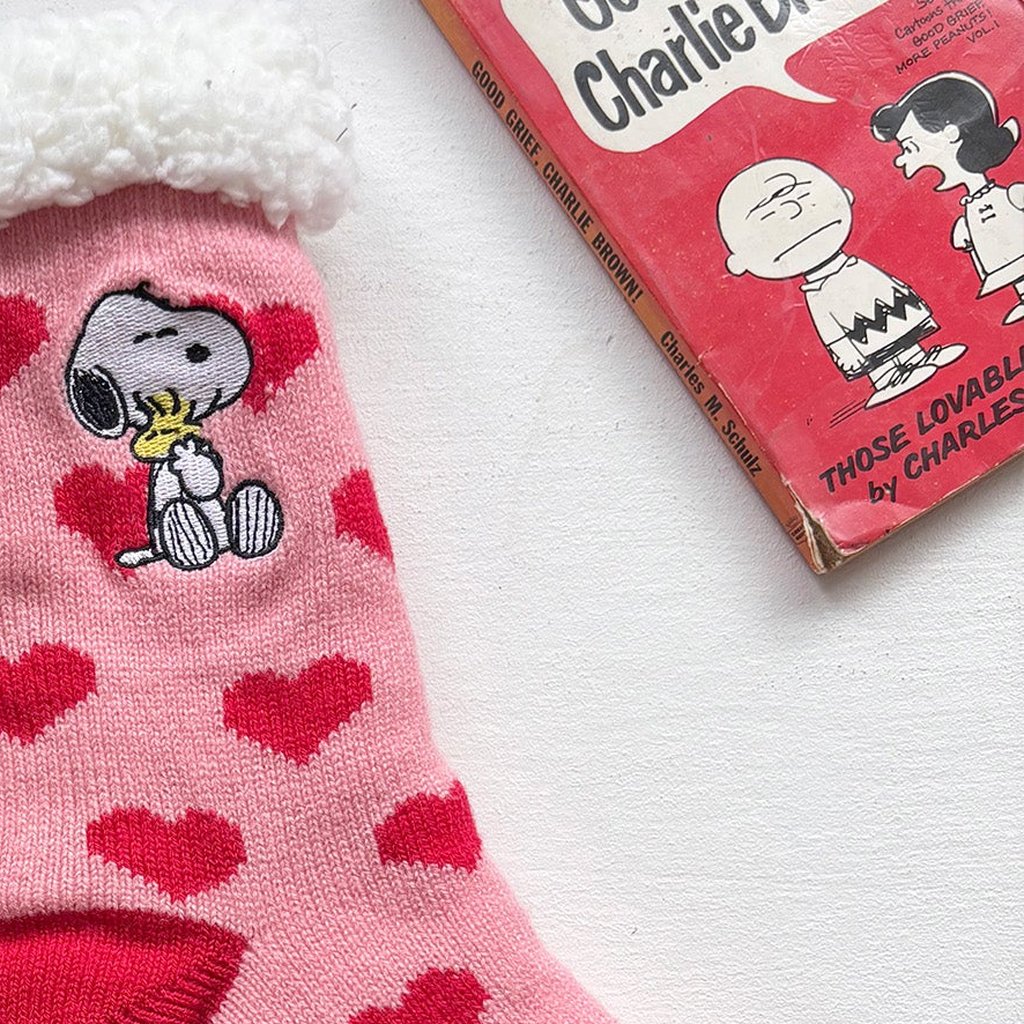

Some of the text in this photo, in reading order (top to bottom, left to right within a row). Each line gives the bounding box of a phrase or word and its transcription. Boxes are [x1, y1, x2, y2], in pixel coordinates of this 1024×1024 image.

[894, 6, 944, 40] Cartoons
[896, 46, 932, 75] MORE
[912, 22, 945, 48] GOOD
[573, 0, 756, 131] Charlie
[471, 60, 505, 110] GOOD
[542, 161, 594, 235] CHARLIE
[591, 231, 644, 303] BROWN!
[660, 330, 763, 478] Charles M. Schulz
[903, 387, 1024, 480] CHARLES
[819, 423, 911, 493] THOSE
